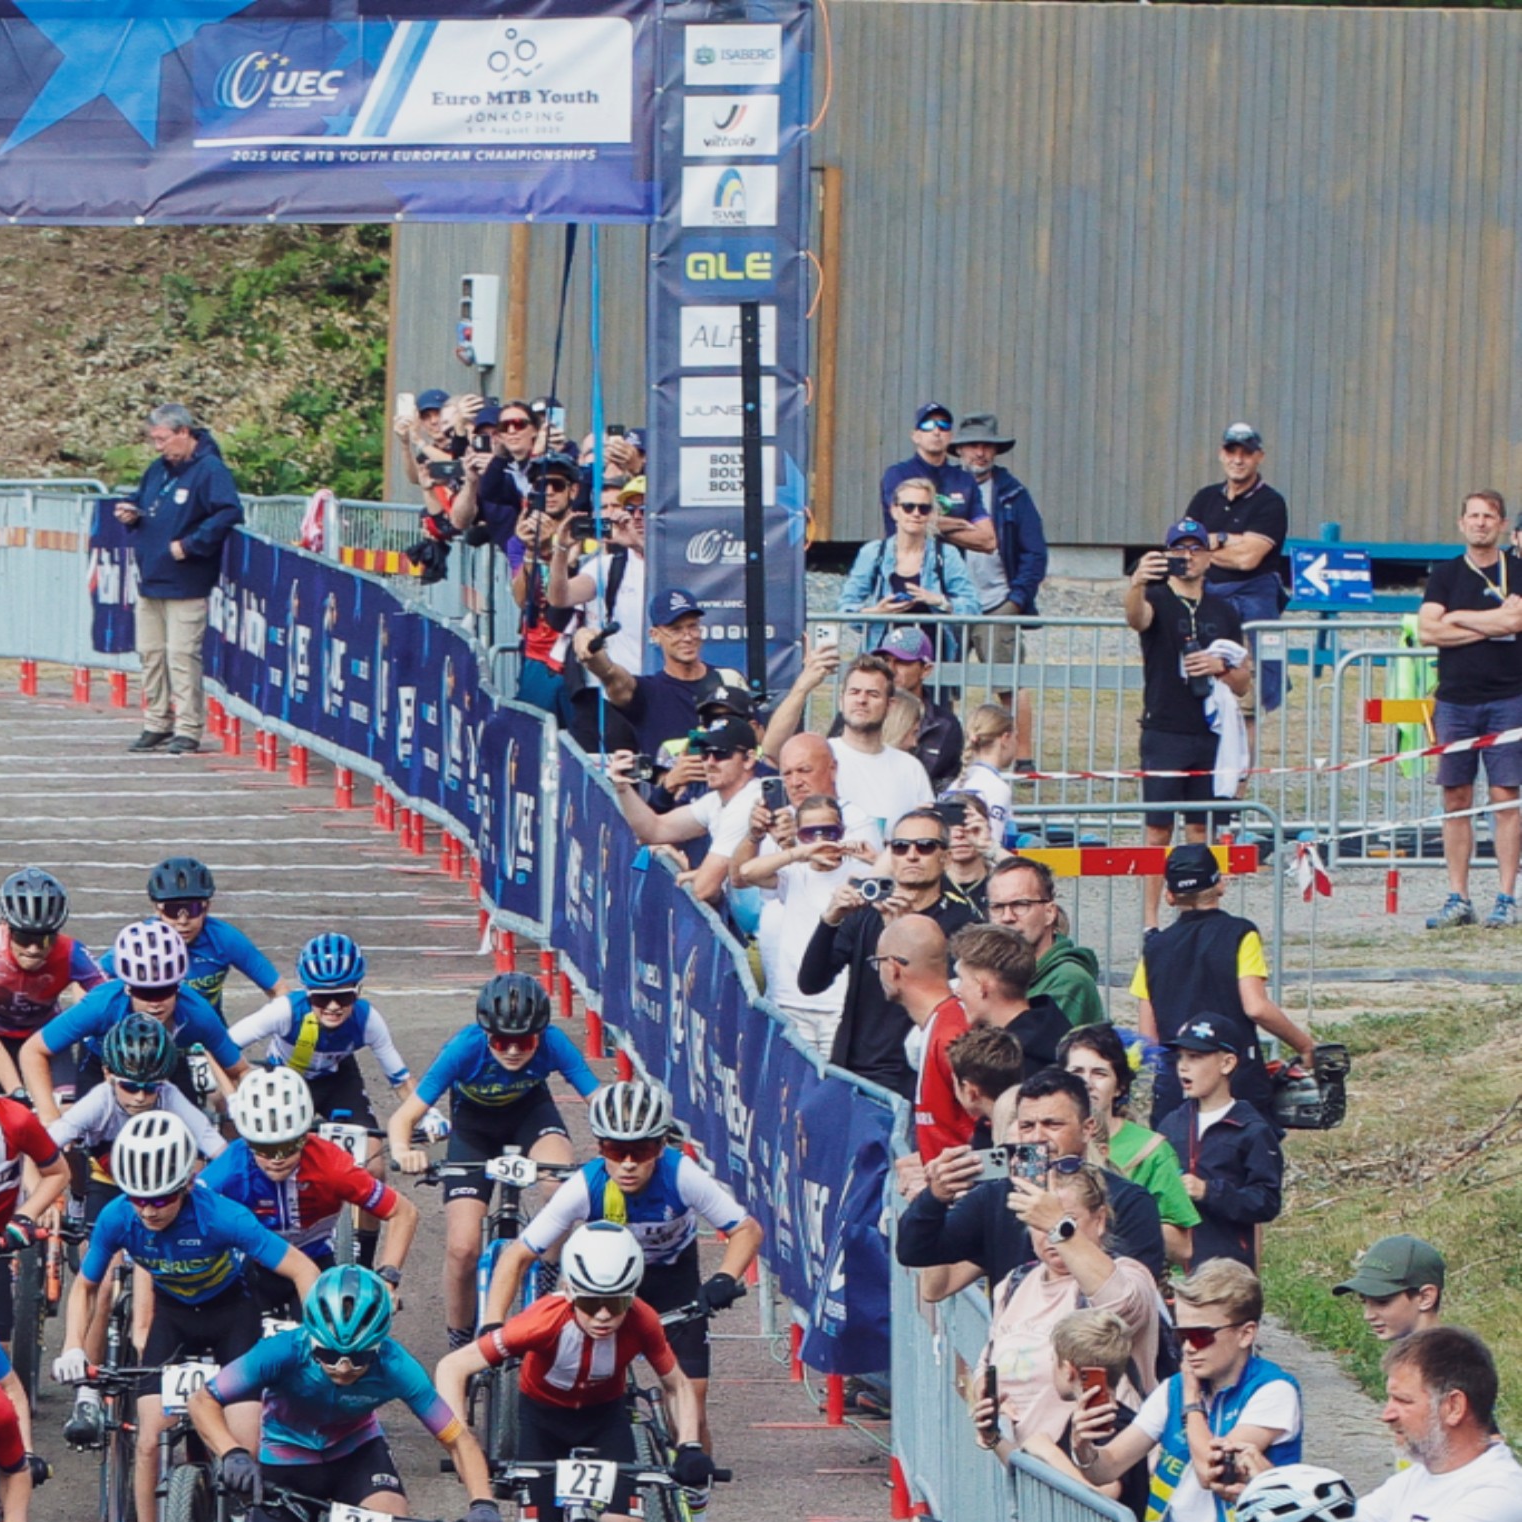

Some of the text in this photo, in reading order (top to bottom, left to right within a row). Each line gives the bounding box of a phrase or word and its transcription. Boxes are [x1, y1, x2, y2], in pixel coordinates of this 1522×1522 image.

[721, 48, 776, 61] ISABERG
[272, 69, 345, 96] UEC
[432, 89, 600, 106] Euro MTB Youth
[704, 136, 757, 148] vittoria
[231, 148, 598, 162] 2025 UEC MTB YOUTH EUROPEAN CHAMPIONSHIPS
[497, 1161, 526, 1180] 56
[174, 1369, 206, 1397] 40
[570, 1462, 603, 1497] 27
